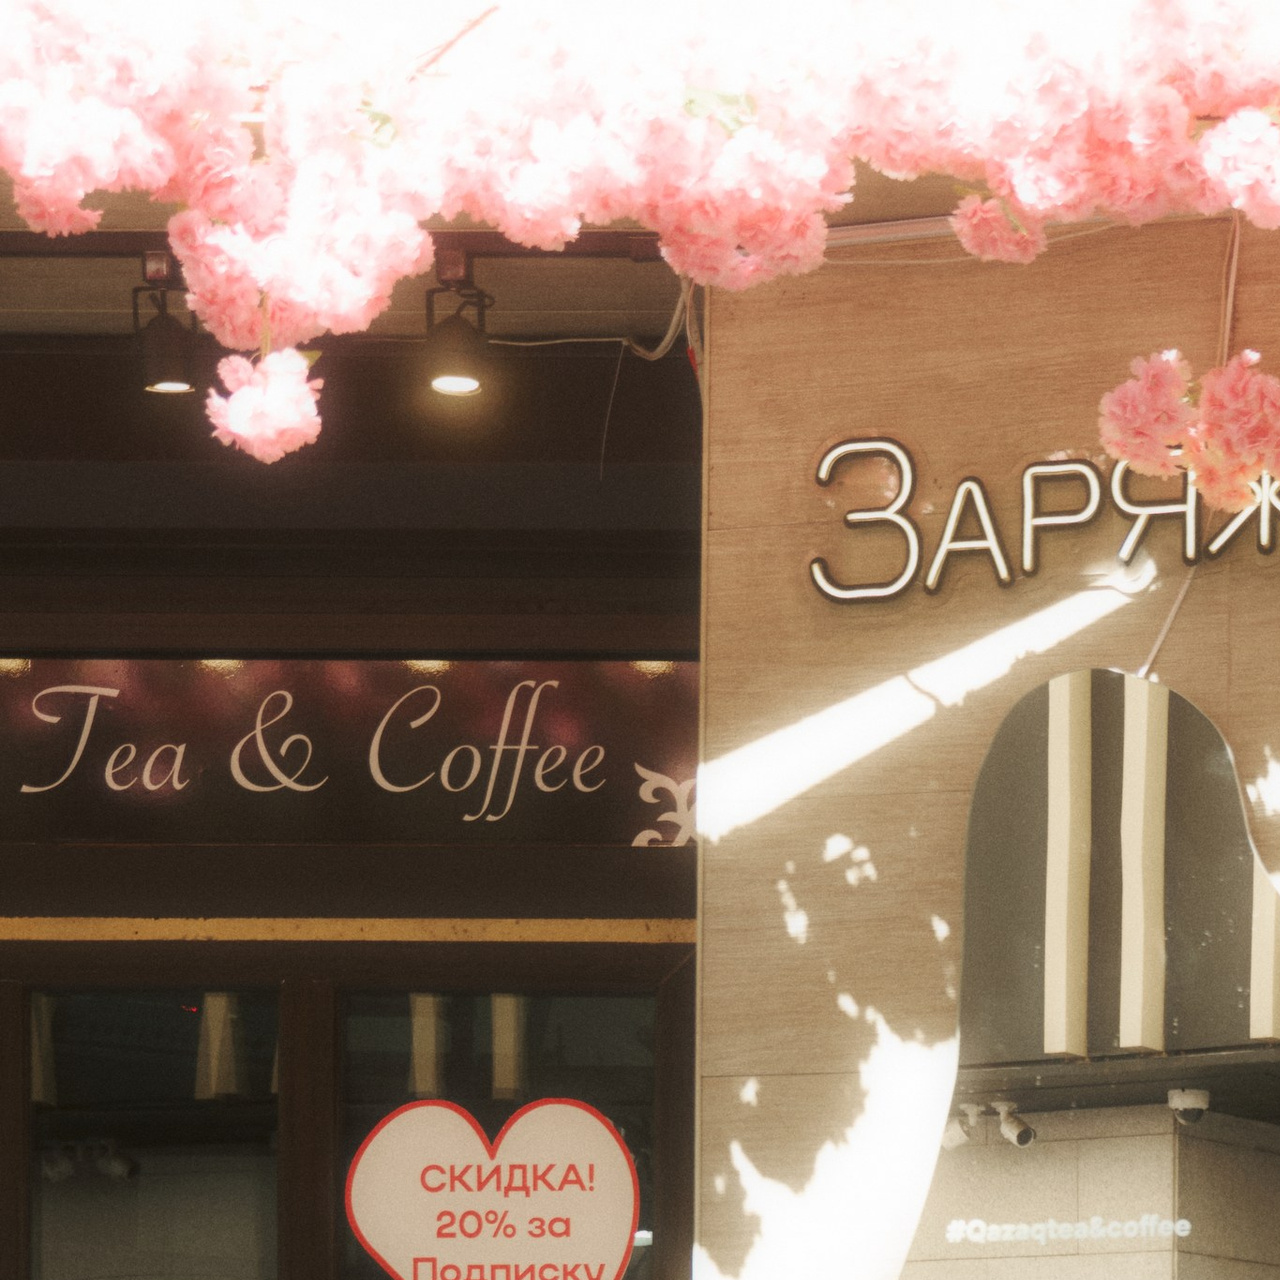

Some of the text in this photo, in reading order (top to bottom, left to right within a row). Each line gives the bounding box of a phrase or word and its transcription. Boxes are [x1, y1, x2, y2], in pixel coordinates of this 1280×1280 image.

[20, 680, 607, 821] Tea & Coffee
[420, 1164, 595, 1198] СКИДКА!
[436, 1210, 571, 1239] 20% за
